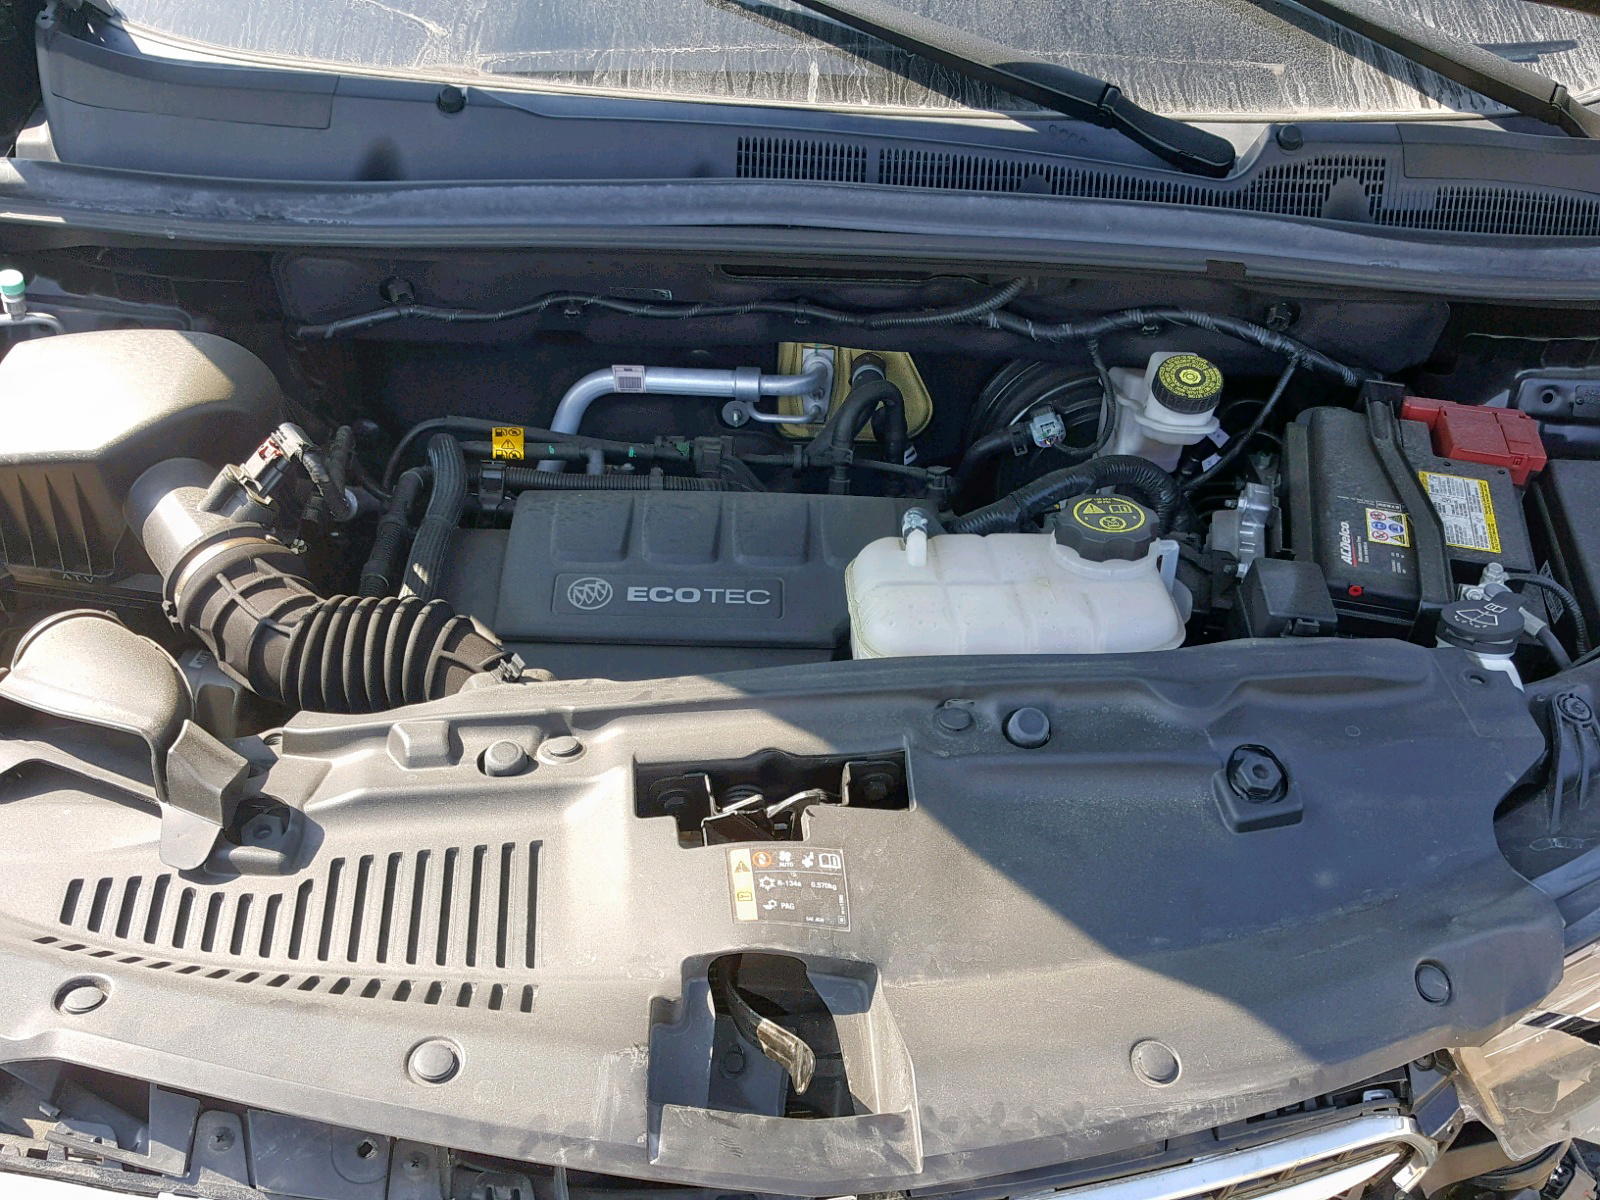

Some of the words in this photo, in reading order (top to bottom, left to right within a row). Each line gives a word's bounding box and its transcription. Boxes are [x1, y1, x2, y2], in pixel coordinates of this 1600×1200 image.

[1339, 522, 1352, 565] ACDelco
[627, 586, 771, 605] ECOTEC
[780, 902, 795, 910] PAG
